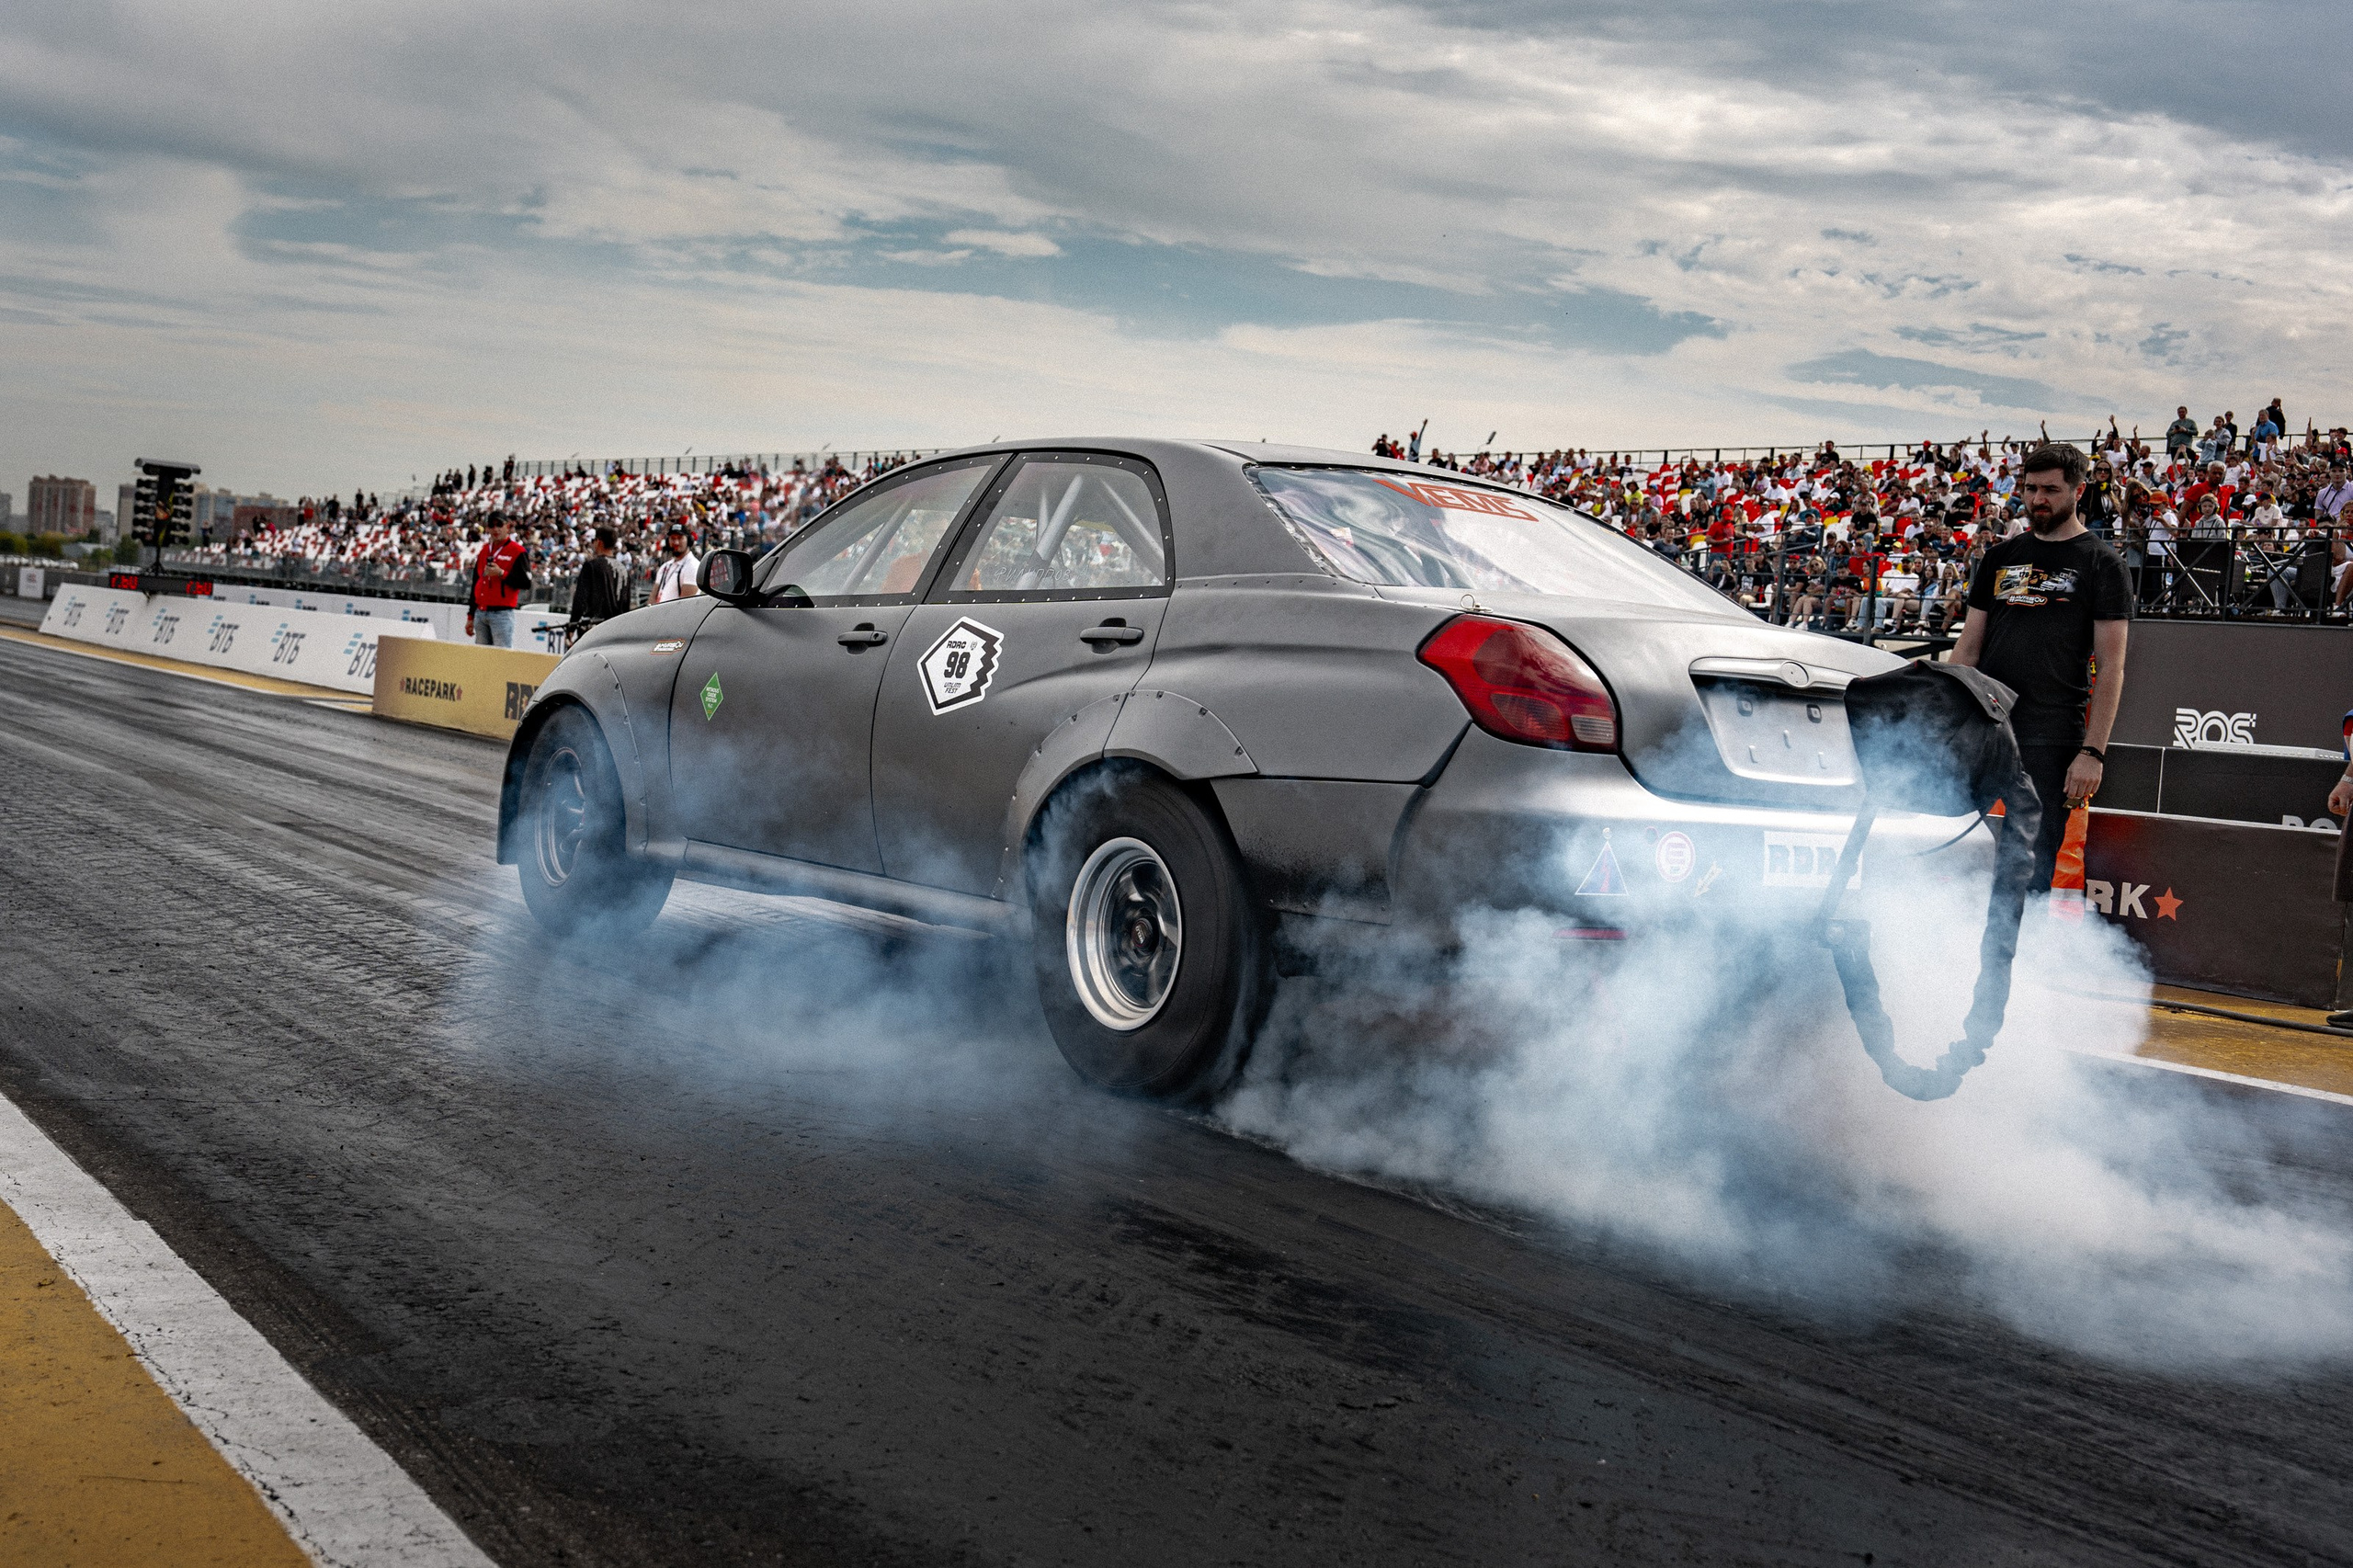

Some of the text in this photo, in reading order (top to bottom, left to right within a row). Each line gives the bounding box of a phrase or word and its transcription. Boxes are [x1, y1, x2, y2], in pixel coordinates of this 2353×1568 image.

[1372, 479, 1540, 522] VEMS
[209, 623, 240, 653] ВТБ
[273, 631, 306, 665] ВТБ
[946, 640, 967, 649] RDRC
[944, 651, 971, 678] 98
[404, 676, 458, 701] RACEPARK
